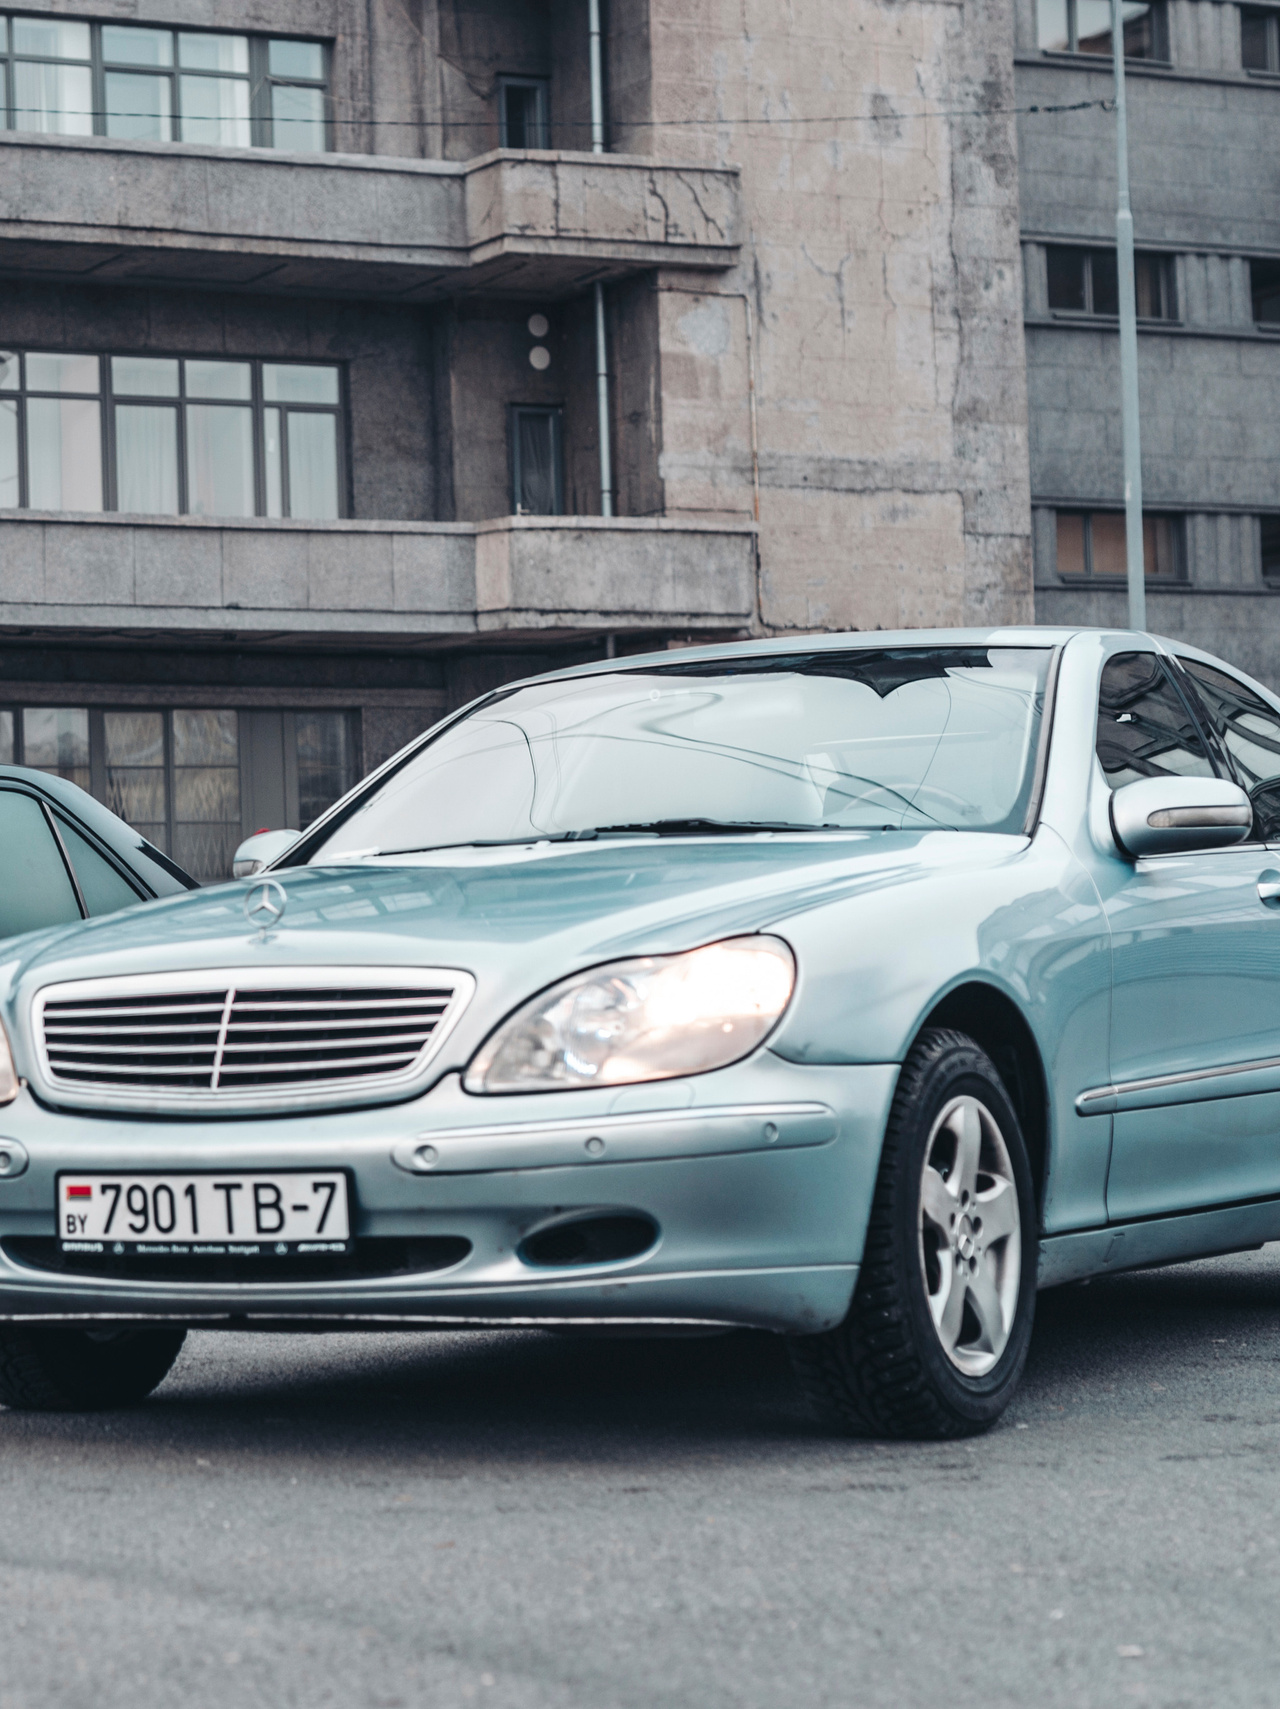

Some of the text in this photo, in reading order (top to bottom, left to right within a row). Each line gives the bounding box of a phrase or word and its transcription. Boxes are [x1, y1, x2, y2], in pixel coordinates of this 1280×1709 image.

[66, 1214, 88, 1235] BY
[100, 1182, 337, 1235] 7901 TB-7
